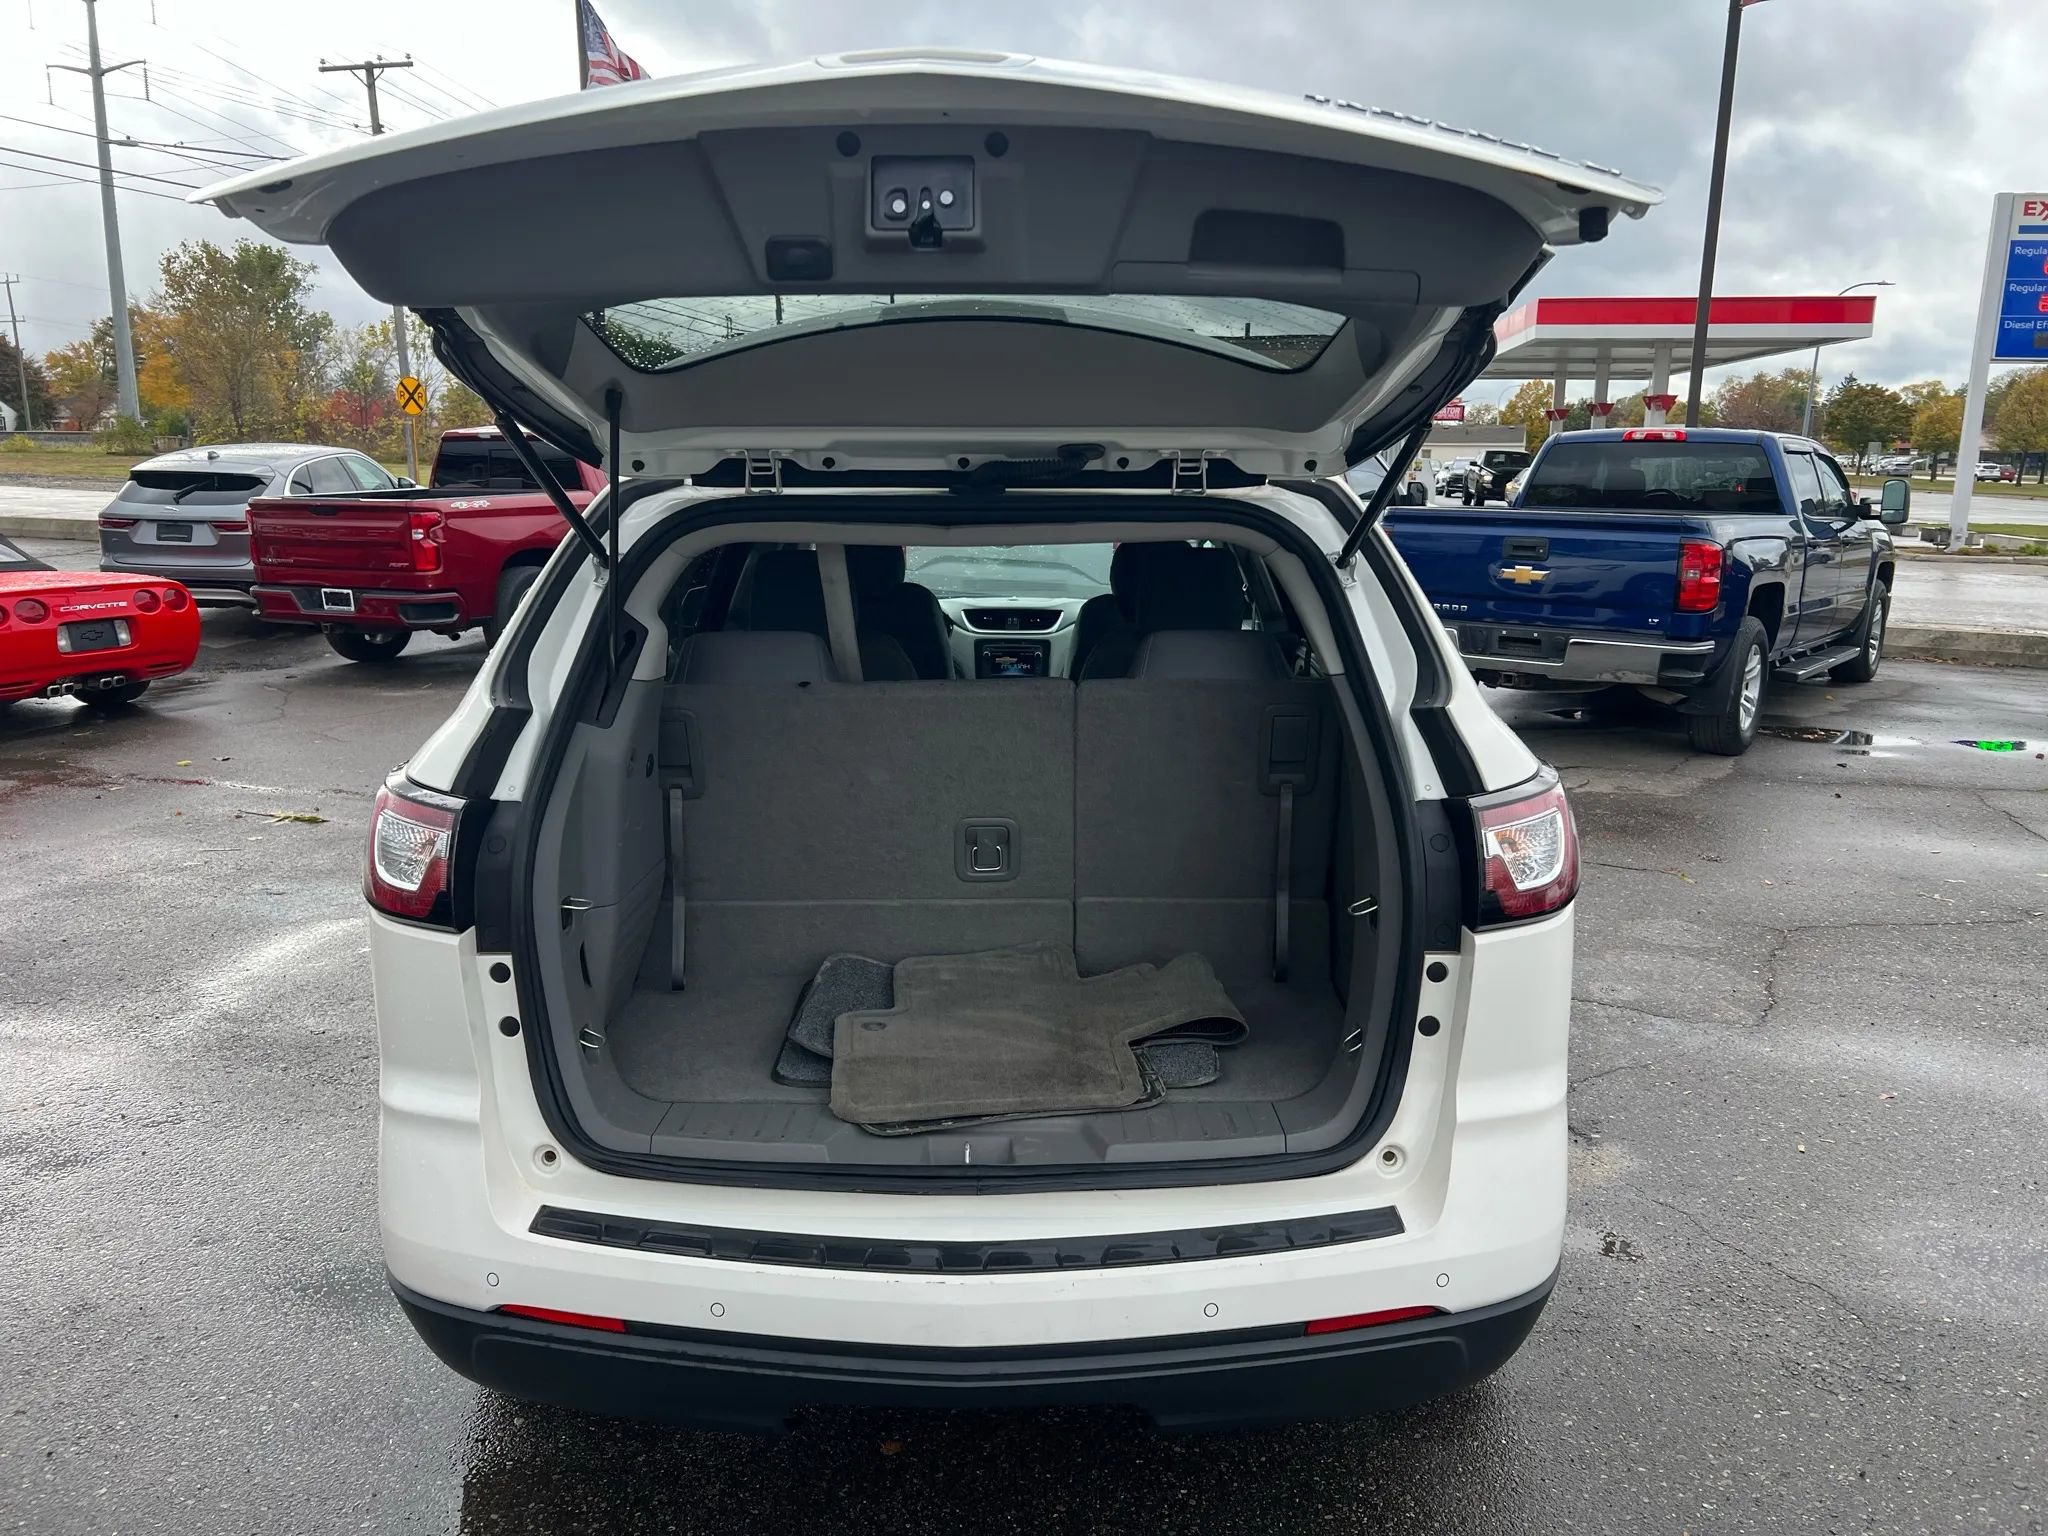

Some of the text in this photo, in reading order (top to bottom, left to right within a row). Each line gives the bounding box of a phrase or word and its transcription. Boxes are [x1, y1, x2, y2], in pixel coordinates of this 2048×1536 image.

[2009, 283, 2047, 294] Regular
[2004, 320, 2034, 329] Diesel
[60, 601, 128, 612] CORVETTE
